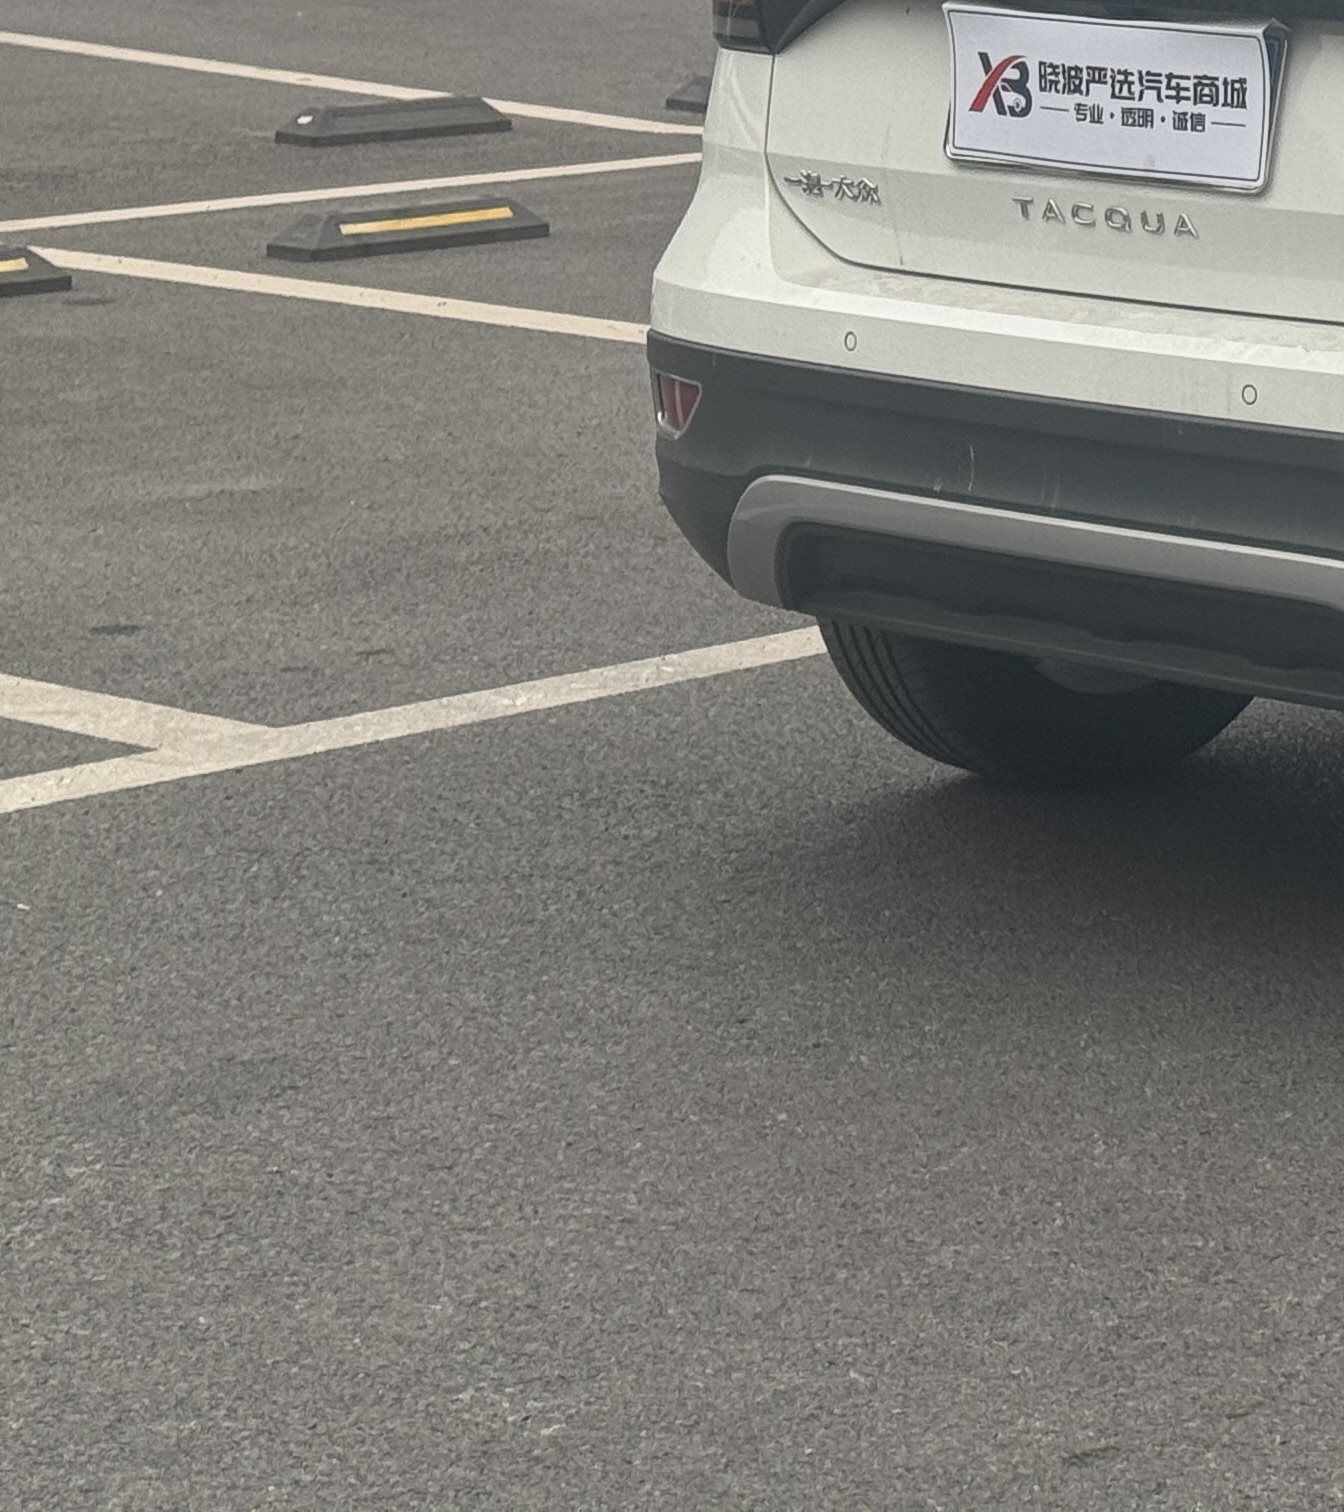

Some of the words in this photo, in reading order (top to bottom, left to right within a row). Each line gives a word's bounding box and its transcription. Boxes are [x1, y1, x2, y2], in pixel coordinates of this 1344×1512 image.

[1038, 60, 1248, 109] 晓波严选汽车商城
[1012, 196, 1200, 239] TACQUA
